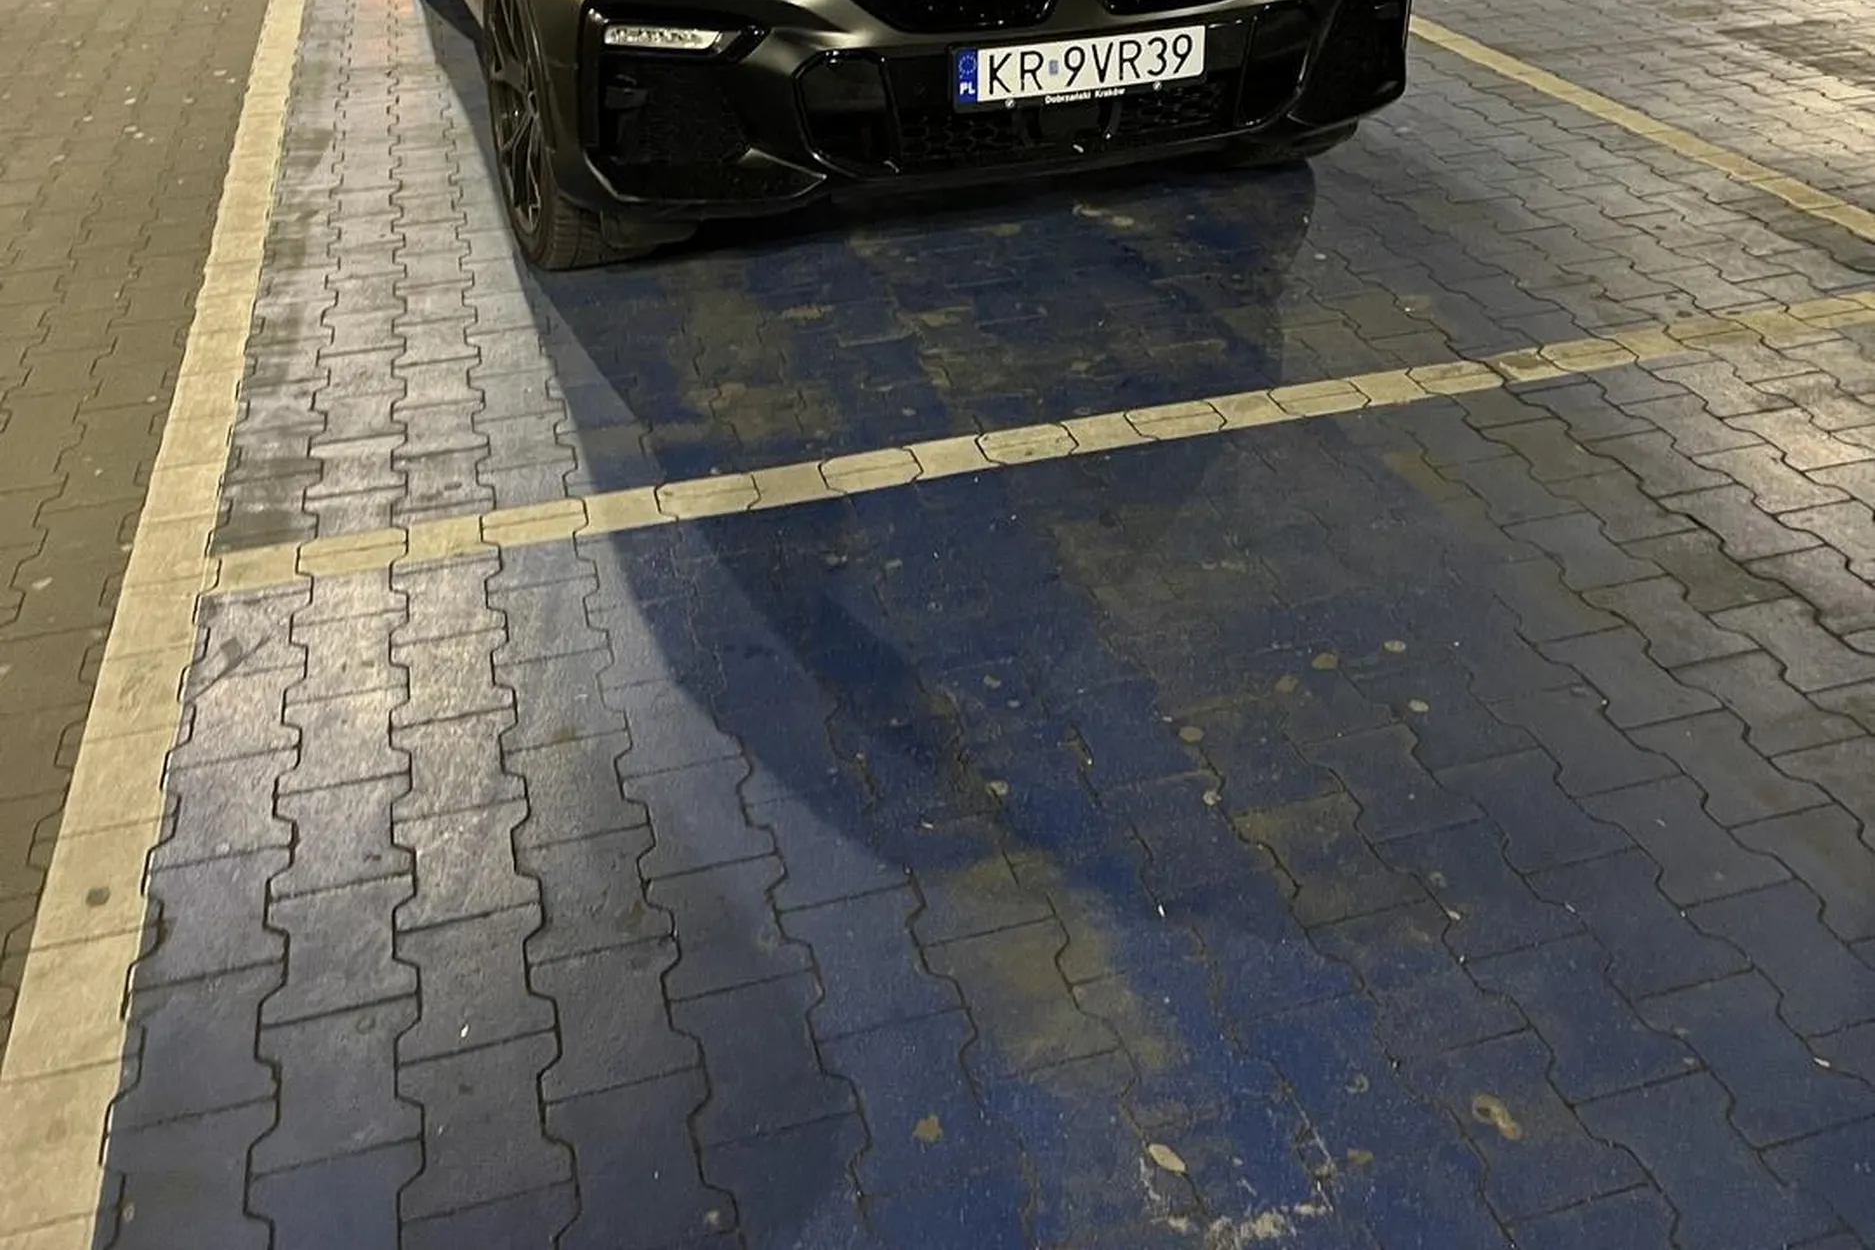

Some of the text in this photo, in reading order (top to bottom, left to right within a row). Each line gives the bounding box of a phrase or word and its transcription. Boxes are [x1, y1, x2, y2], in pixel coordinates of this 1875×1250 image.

[959, 34, 1193, 95] PL KR 9VR39
